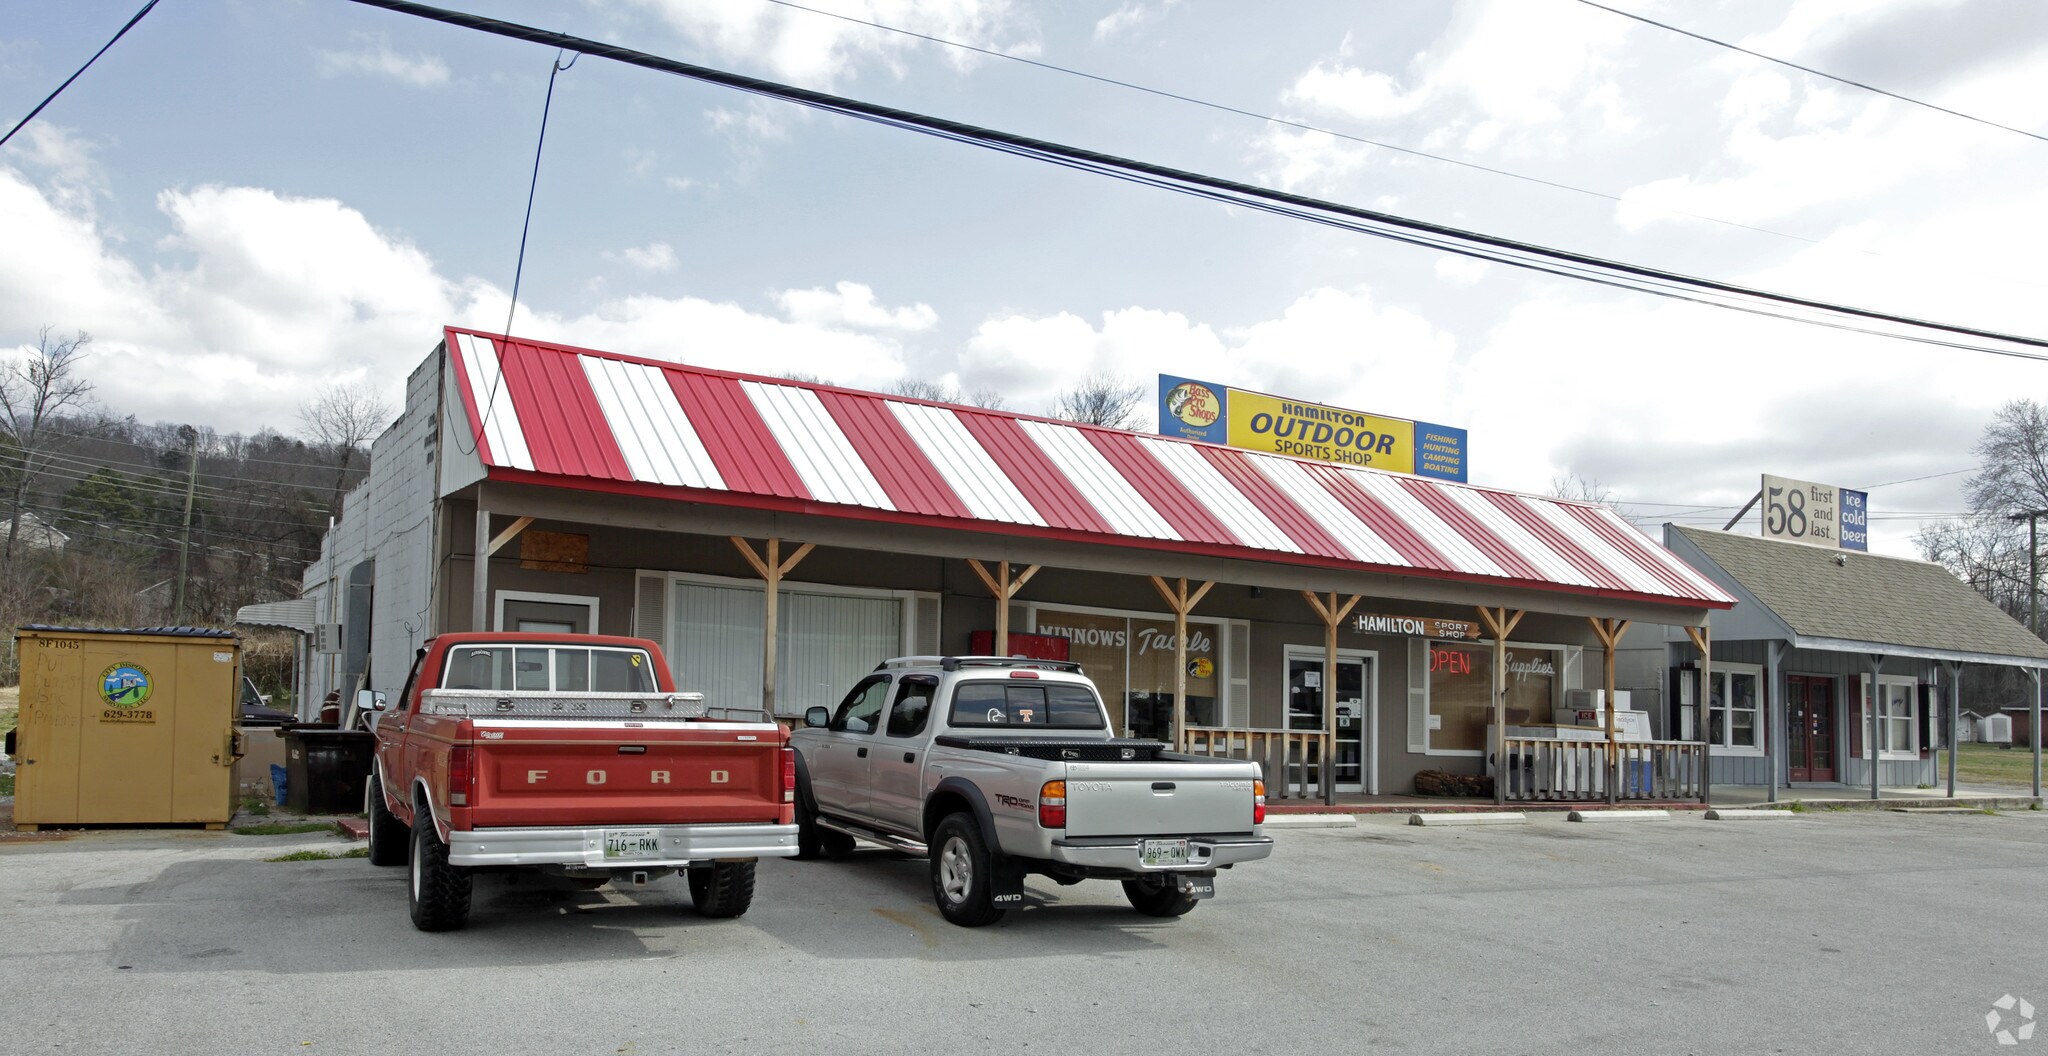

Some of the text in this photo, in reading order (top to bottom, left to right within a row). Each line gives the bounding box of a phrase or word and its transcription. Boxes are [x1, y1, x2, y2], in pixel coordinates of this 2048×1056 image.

[1189, 384, 1209, 399] Bass
[1191, 395, 1205, 408] Pro
[1189, 405, 1216, 422] Shops
[1282, 403, 1365, 427] HAMILTON
[1180, 427, 1207, 437] Authorized
[1250, 413, 1395, 455] OUTDOOR
[1425, 433, 1457, 445] FISHING
[1275, 439, 1372, 465] SPORTS SHOP
[1423, 443, 1459, 455] HUNTING
[1423, 453, 1460, 465] CAMPING
[1423, 463, 1459, 474] BOATING
[1811, 486, 1832, 503] first
[1846, 491, 1860, 507] ice
[1767, 486, 1807, 537] 58
[1814, 507, 1833, 521] and
[1842, 510, 1865, 526] cold
[1841, 525, 1866, 544] beer
[1359, 615, 1469, 636] HAMILTON SPORT
[1439, 630, 1466, 639] SHOP
[103, 710, 153, 719] 629-3778
[527, 770, 729, 784] FORD
[1071, 782, 1113, 792] TOYOTA
[995, 793, 1018, 808] TRD
[994, 894, 1022, 902] 4WD
